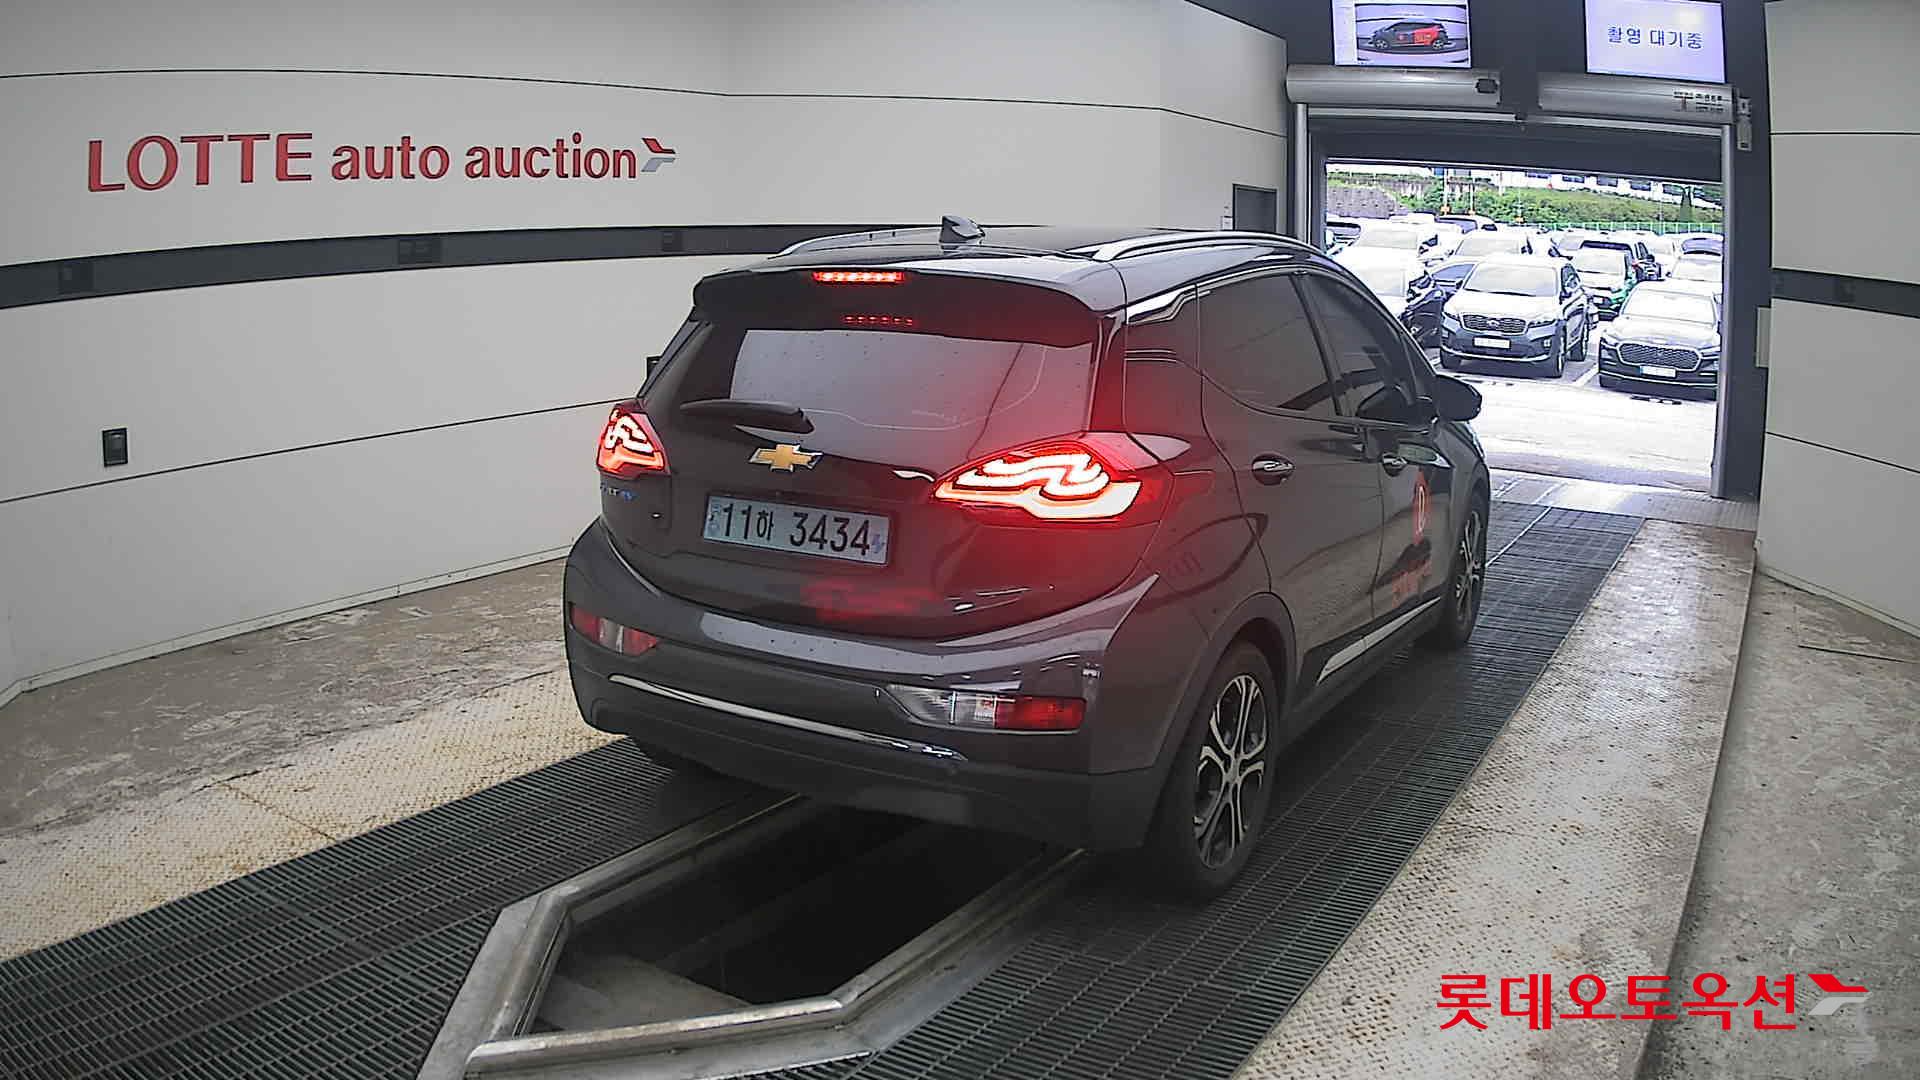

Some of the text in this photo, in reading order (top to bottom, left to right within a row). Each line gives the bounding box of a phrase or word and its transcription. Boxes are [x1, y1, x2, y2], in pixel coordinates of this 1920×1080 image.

[1607, 25, 1703, 49] 촬영 대기중
[88, 132, 637, 192] LOTTE auto auction
[723, 503, 870, 556] 11하 3434
